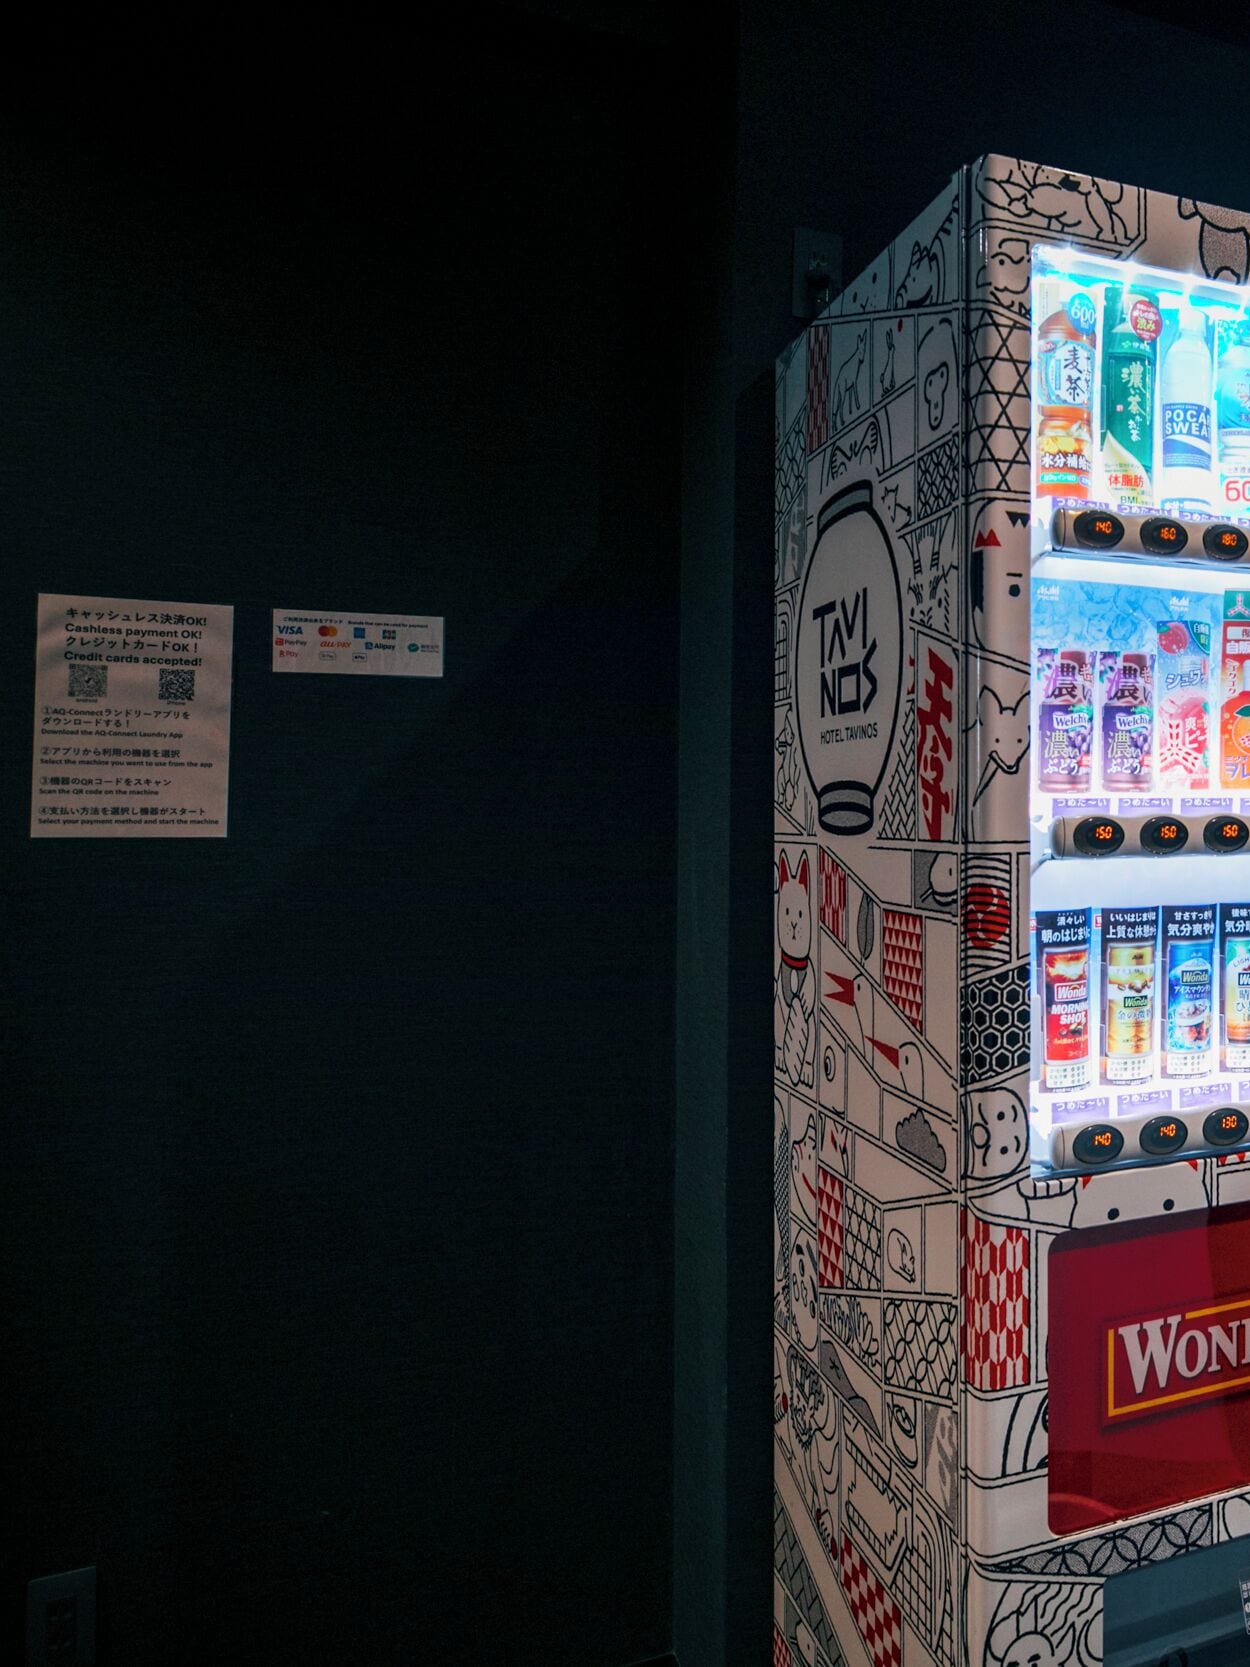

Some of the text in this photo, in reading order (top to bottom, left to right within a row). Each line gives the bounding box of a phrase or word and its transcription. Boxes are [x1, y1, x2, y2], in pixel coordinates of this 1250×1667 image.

[1064, 346, 1086, 402] 麦茶
[1165, 409, 1210, 426] POCA
[1165, 422, 1210, 437] SWEA
[1109, 473, 1144, 488] 体脂肪
[1095, 521, 1113, 535] 140
[67, 608, 207, 626] キャッシュレス決済OK!
[65, 623, 202, 640] Cashless payment OK!
[277, 625, 304, 635] VISA
[813, 587, 868, 668] TAVI
[64, 651, 202, 667] Credit cards accepted!
[821, 637, 878, 719] NOS
[820, 722, 878, 745] HOTEL TAVINOS
[1043, 757, 1079, 775] ぶどう
[1107, 757, 1142, 775] ぶどう
[1095, 825, 1113, 839] 150
[1161, 825, 1177, 839] 150
[1223, 824, 1239, 838] 150
[1221, 1116, 1237, 1128] 130
[1160, 1124, 1176, 1137] 140
[1094, 1133, 1111, 1146] 140
